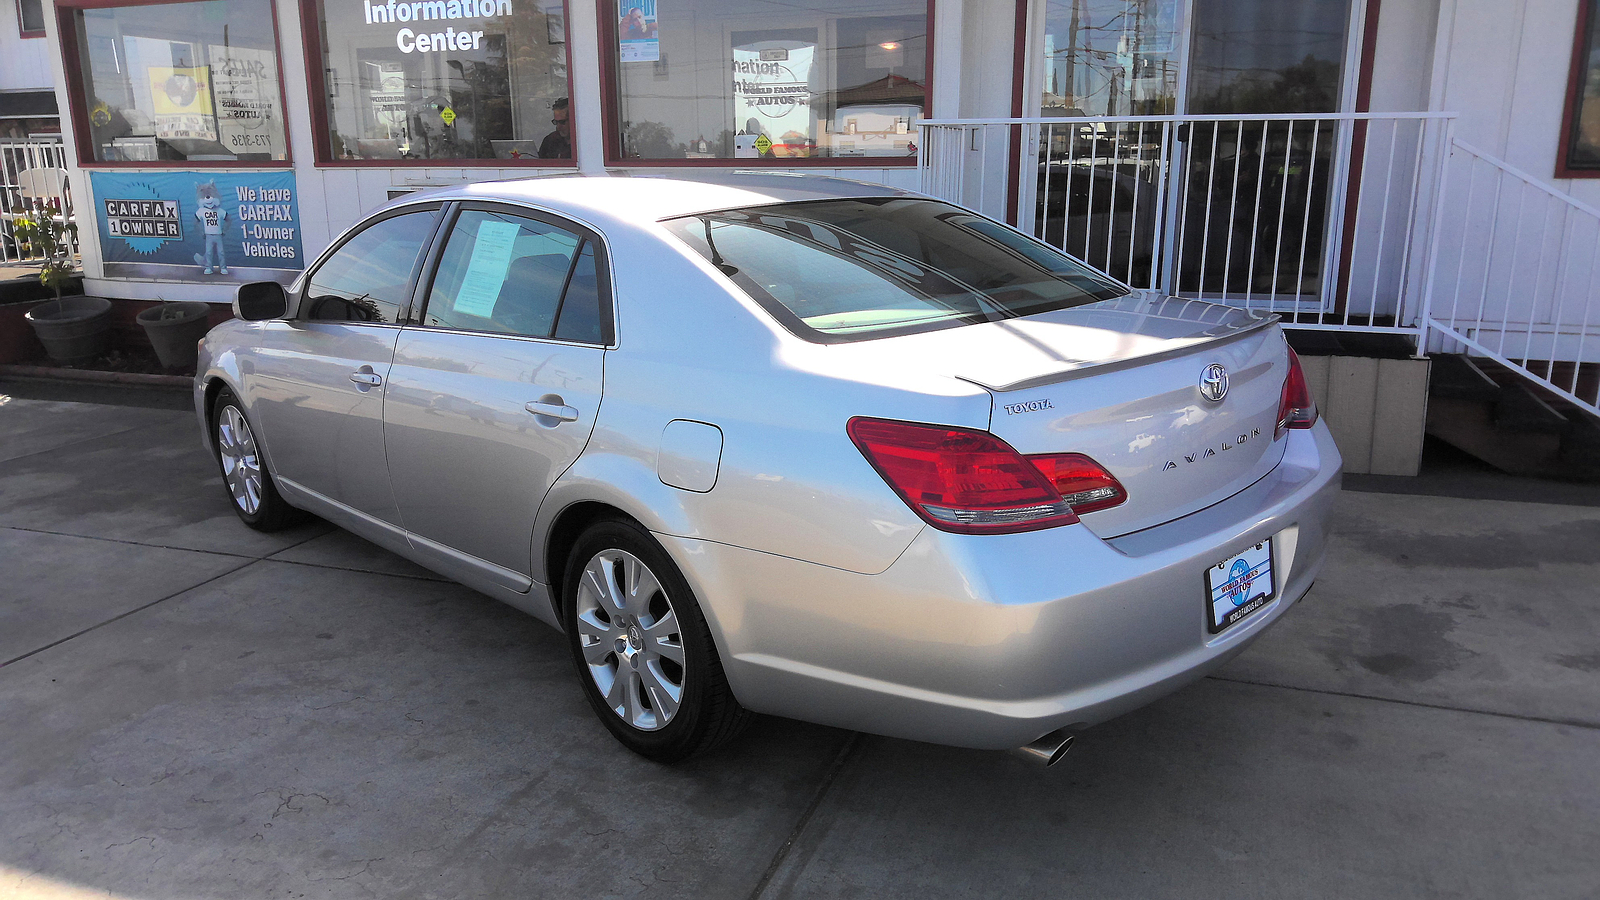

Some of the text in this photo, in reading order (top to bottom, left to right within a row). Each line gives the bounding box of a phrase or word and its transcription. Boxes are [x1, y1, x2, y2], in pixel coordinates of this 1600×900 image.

[364, 0, 513, 24] Information
[396, 27, 484, 54] Center
[756, 96, 795, 106] AUTOS
[236, 186, 291, 202] We have
[106, 202, 176, 219] CARFAX
[204, 212, 218, 220] CAR
[238, 204, 293, 222] CARFAX
[206, 219, 219, 227] FOX
[241, 224, 295, 240] 1-Owner
[242, 241, 296, 259] Vehicles
[1004, 399, 1055, 415] TOYOTA
[1162, 427, 1261, 472] AVALON
[1220, 568, 1260, 594] WORLD FAMOUS
[1230, 581, 1252, 598] AUTOS
